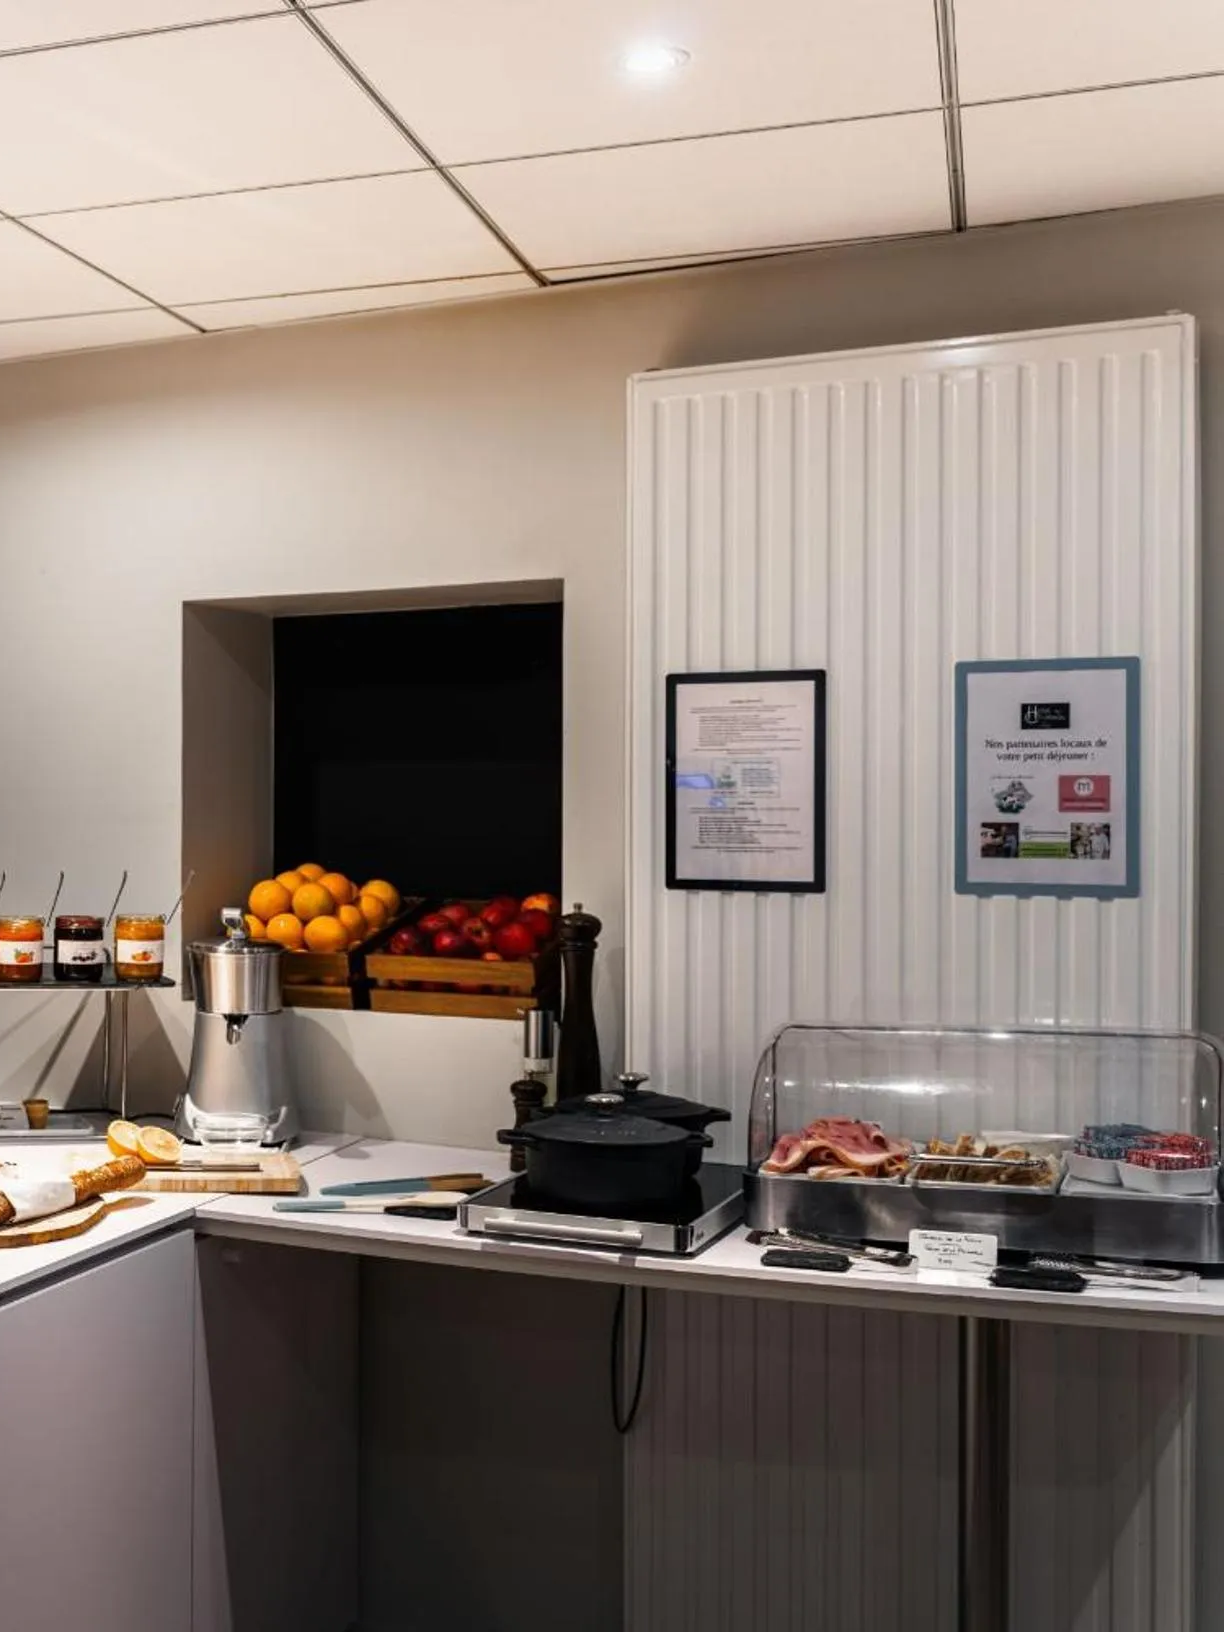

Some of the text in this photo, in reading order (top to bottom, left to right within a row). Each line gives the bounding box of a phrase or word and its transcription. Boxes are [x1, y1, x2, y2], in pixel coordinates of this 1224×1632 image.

[984, 738, 1108, 751] Nos partenaires locaux de
[996, 752, 1021, 761] votre
[1022, 752, 1044, 762] petit
[1047, 750, 1088, 762] déjeuner
